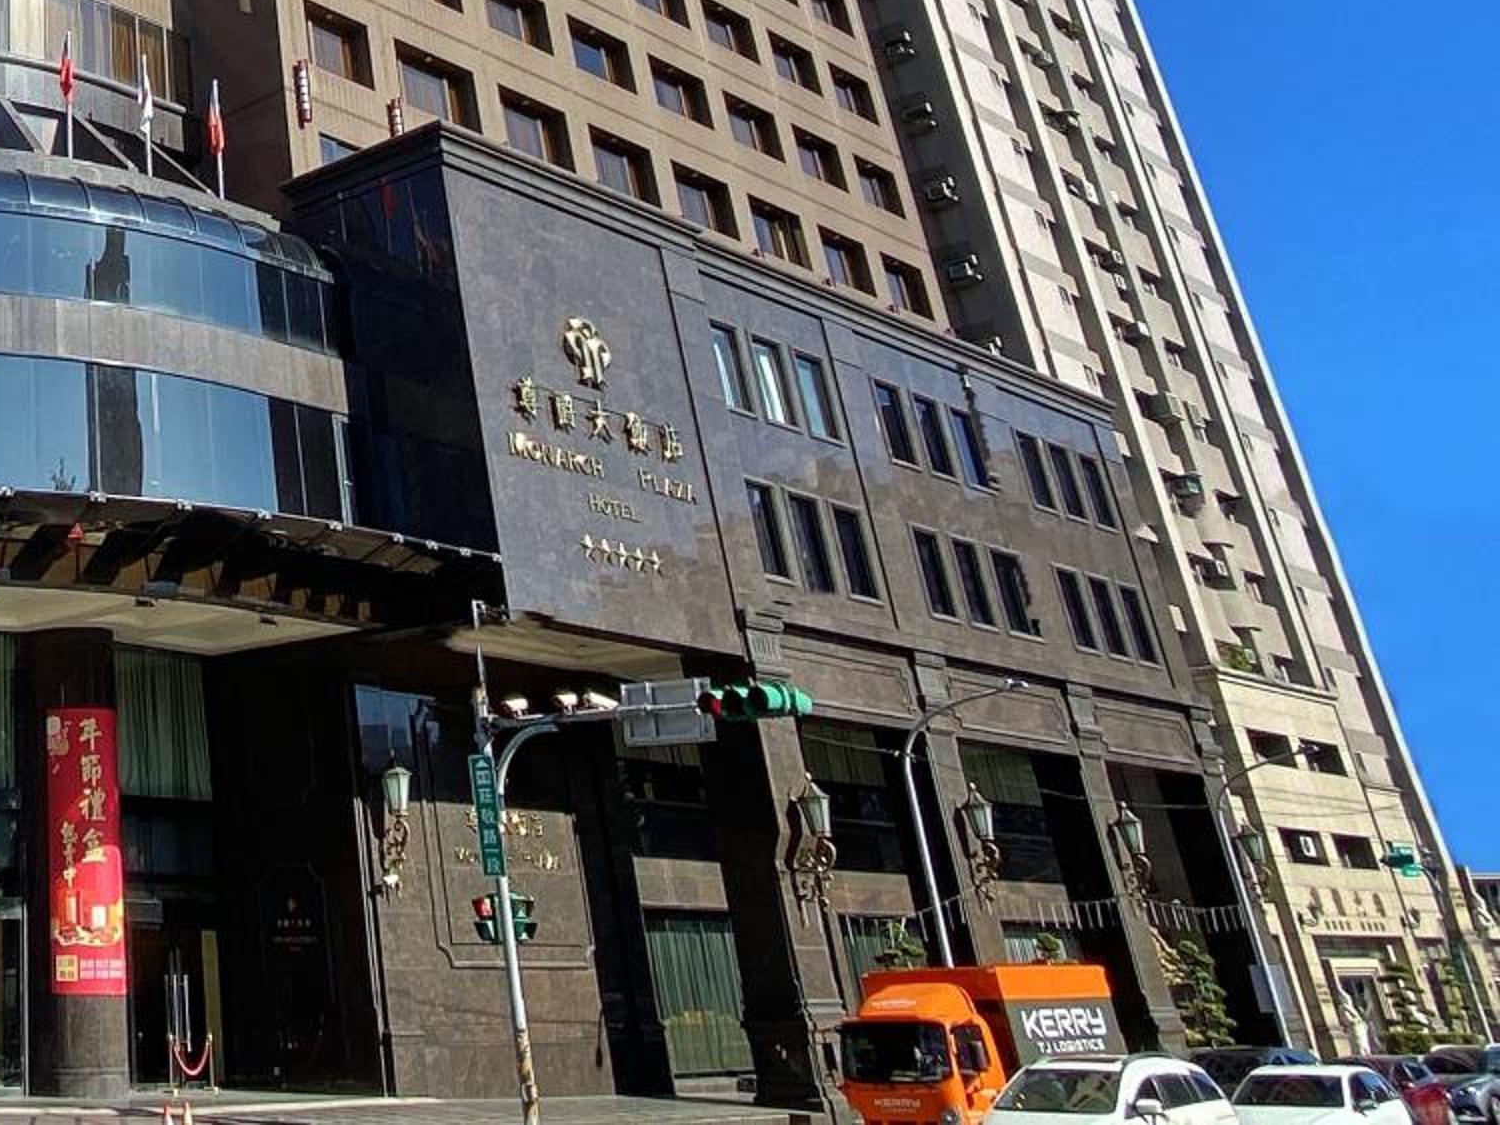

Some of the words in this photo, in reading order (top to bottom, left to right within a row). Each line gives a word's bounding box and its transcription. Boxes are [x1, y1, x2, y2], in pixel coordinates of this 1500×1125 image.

[508, 431, 604, 478] MONARCH
[637, 467, 697, 504] PLAZA
[588, 492, 641, 523] HOTEL
[79, 717, 108, 864] 年節禮盒
[1021, 1007, 1107, 1040] KERRY
